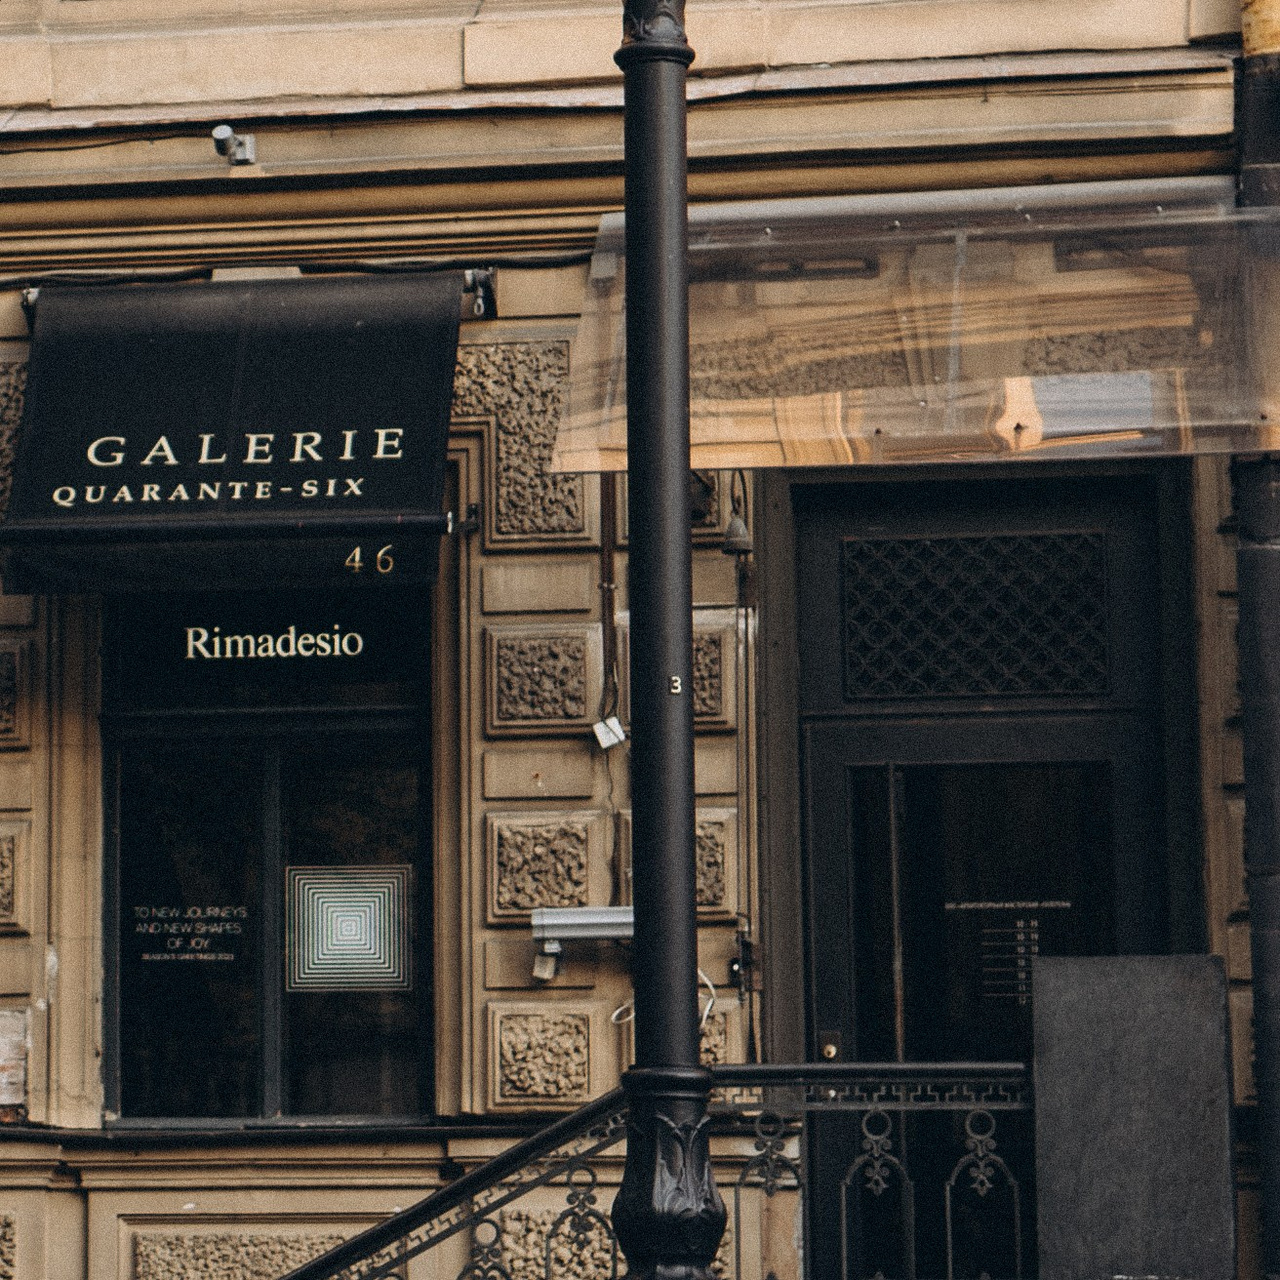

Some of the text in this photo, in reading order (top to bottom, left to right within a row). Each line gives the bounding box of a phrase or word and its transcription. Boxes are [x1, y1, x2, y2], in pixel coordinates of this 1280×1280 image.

[86, 427, 405, 467] GALERIE
[52, 477, 365, 508] QUARANTE-SIX
[345, 545, 394, 573] 46
[186, 623, 365, 659] Rimadesio
[671, 675, 682, 694] 3
[152, 906, 180, 918] NEW
[183, 906, 248, 919] JOURNEYS
[136, 922, 243, 934] AND NEW SHAPES
